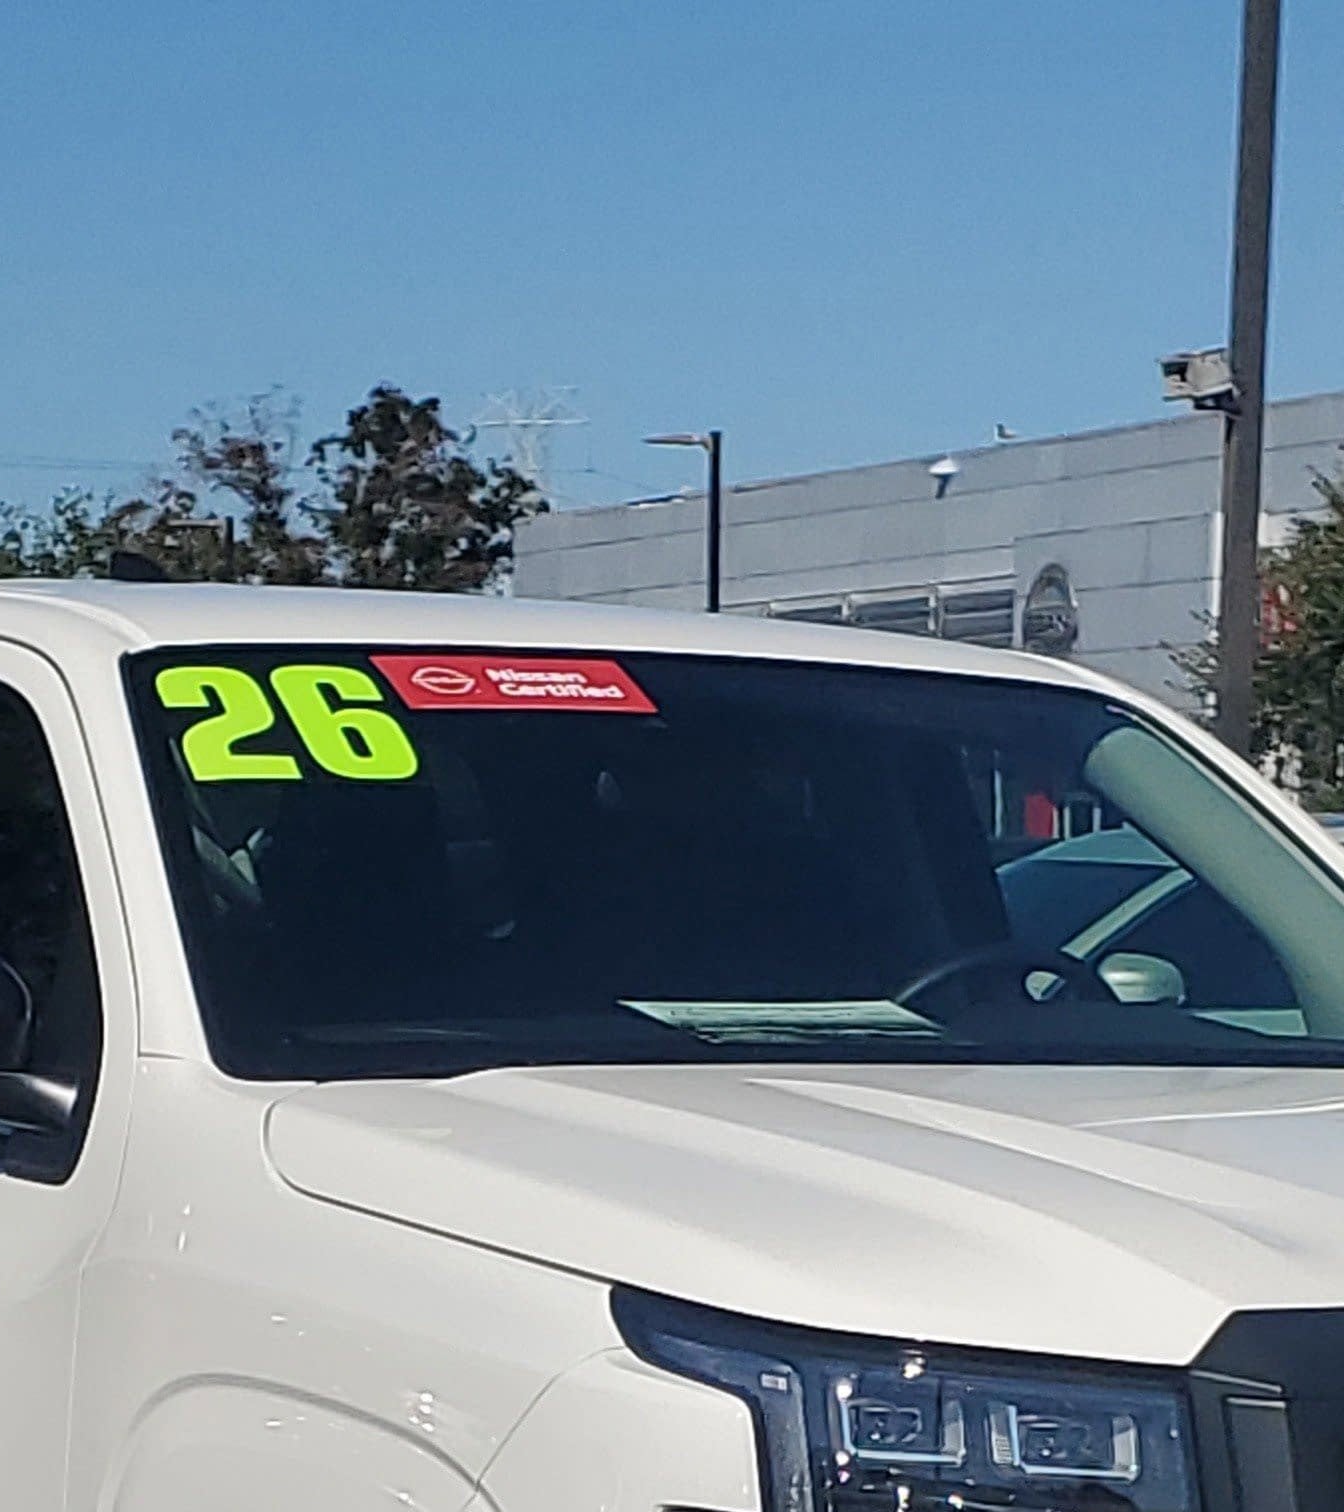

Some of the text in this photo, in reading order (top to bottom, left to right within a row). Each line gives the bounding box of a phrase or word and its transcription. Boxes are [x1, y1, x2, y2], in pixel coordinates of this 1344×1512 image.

[484, 668, 588, 684] Nissan
[498, 684, 626, 698] Certified
[155, 666, 417, 781] 26
